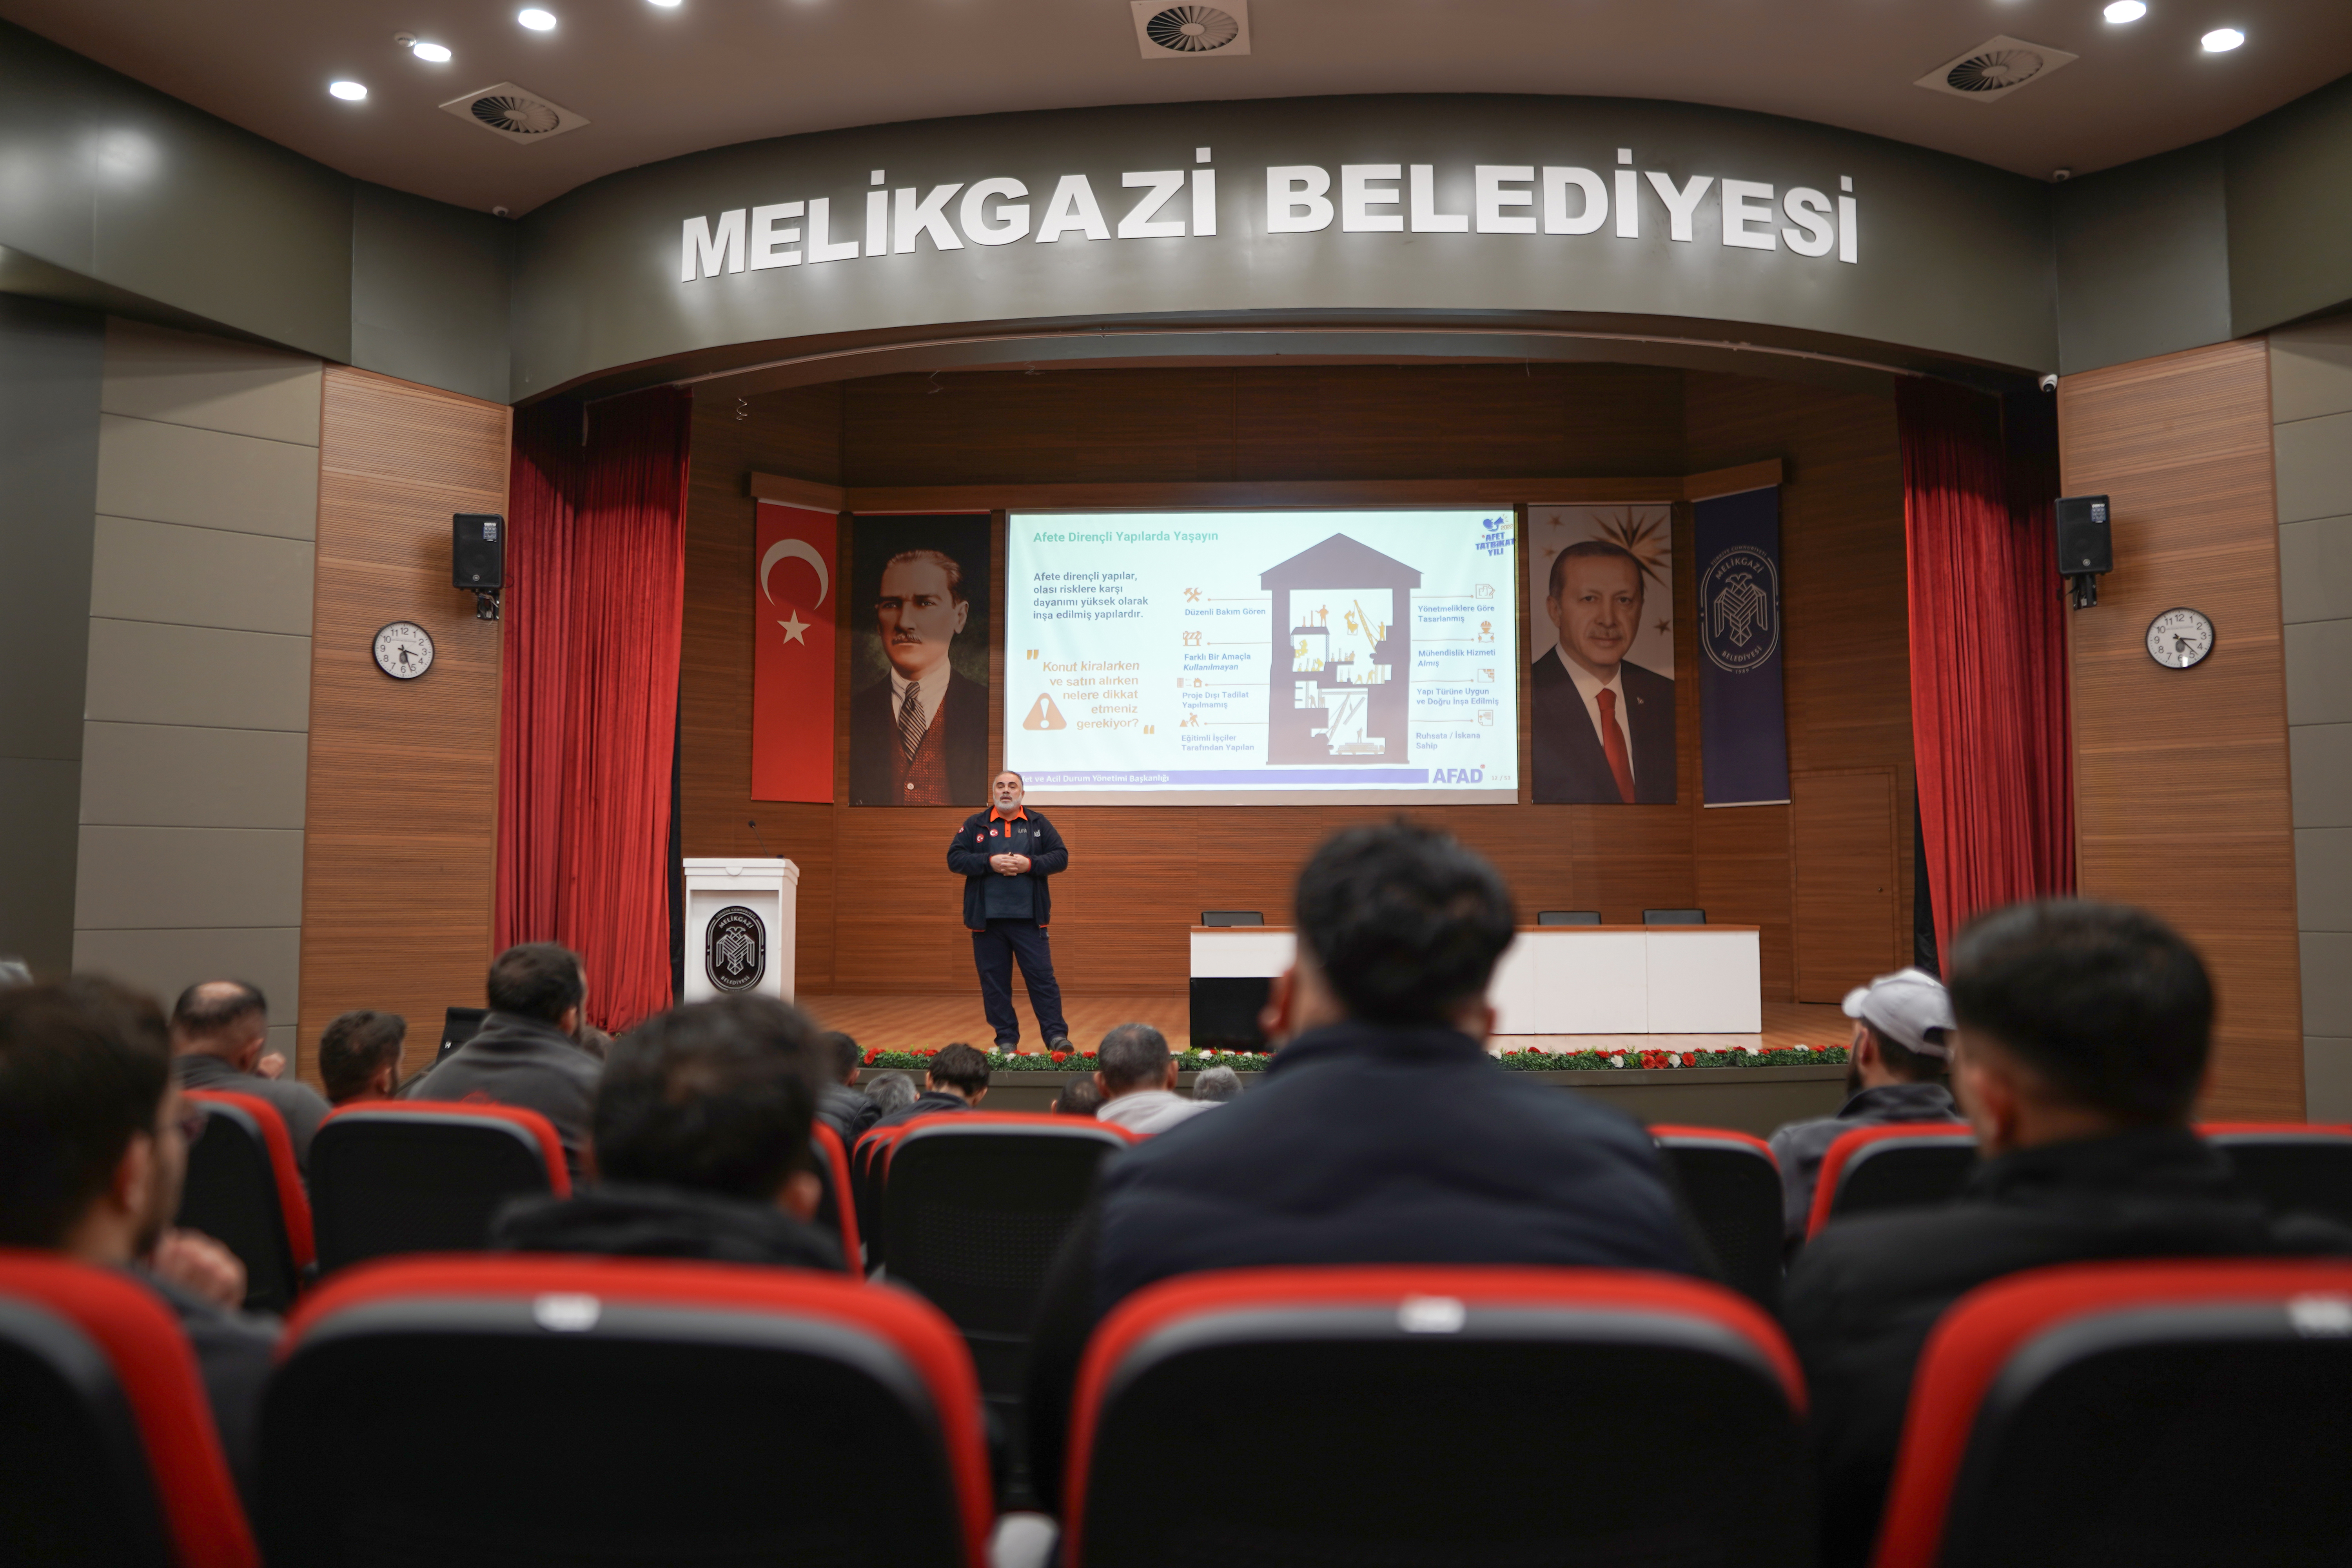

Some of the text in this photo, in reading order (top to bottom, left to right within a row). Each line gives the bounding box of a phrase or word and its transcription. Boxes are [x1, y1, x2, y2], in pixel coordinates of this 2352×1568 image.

[681, 147, 1858, 282] MELİKGAZİ BELEDİYESİ
[1033, 531, 1218, 544] Afete Dirençli Yapılarda Yaşayın
[1486, 532, 1505, 541] AFET
[1488, 548, 1504, 557] YILI
[1715, 557, 1764, 579] MELİKGAZİ
[1034, 572, 1137, 582] Afete dirençli yapılar,
[1034, 584, 1123, 594] olası risklere karşı
[1034, 596, 1148, 608] dayanımı yüksek olarak
[1034, 609, 1143, 621] inşa edilmiş yapılardır.
[1222, 653, 1250, 661] Amaçla
[1722, 646, 1762, 662] BELEDİYESİ
[1043, 661, 1140, 671] Konut kiralarken
[1066, 677, 1095, 686] satın
[1098, 676, 1139, 686] alırken
[1063, 690, 1138, 700] nelere dikkat
[1465, 688, 1489, 696] Uygun
[1453, 697, 1468, 706] İnşa
[1091, 704, 1138, 713] etmeniz
[1076, 718, 1139, 730] gerekiyor?
[1213, 733, 1236, 742] İşçiler
[1455, 731, 1481, 739] İskana
[1129, 774, 1169, 783] Başkanlığı
[1433, 769, 1483, 784] AFAD
[719, 915, 755, 929] MELİKGAZİ
[720, 975, 750, 985] BELEDİYESİ
